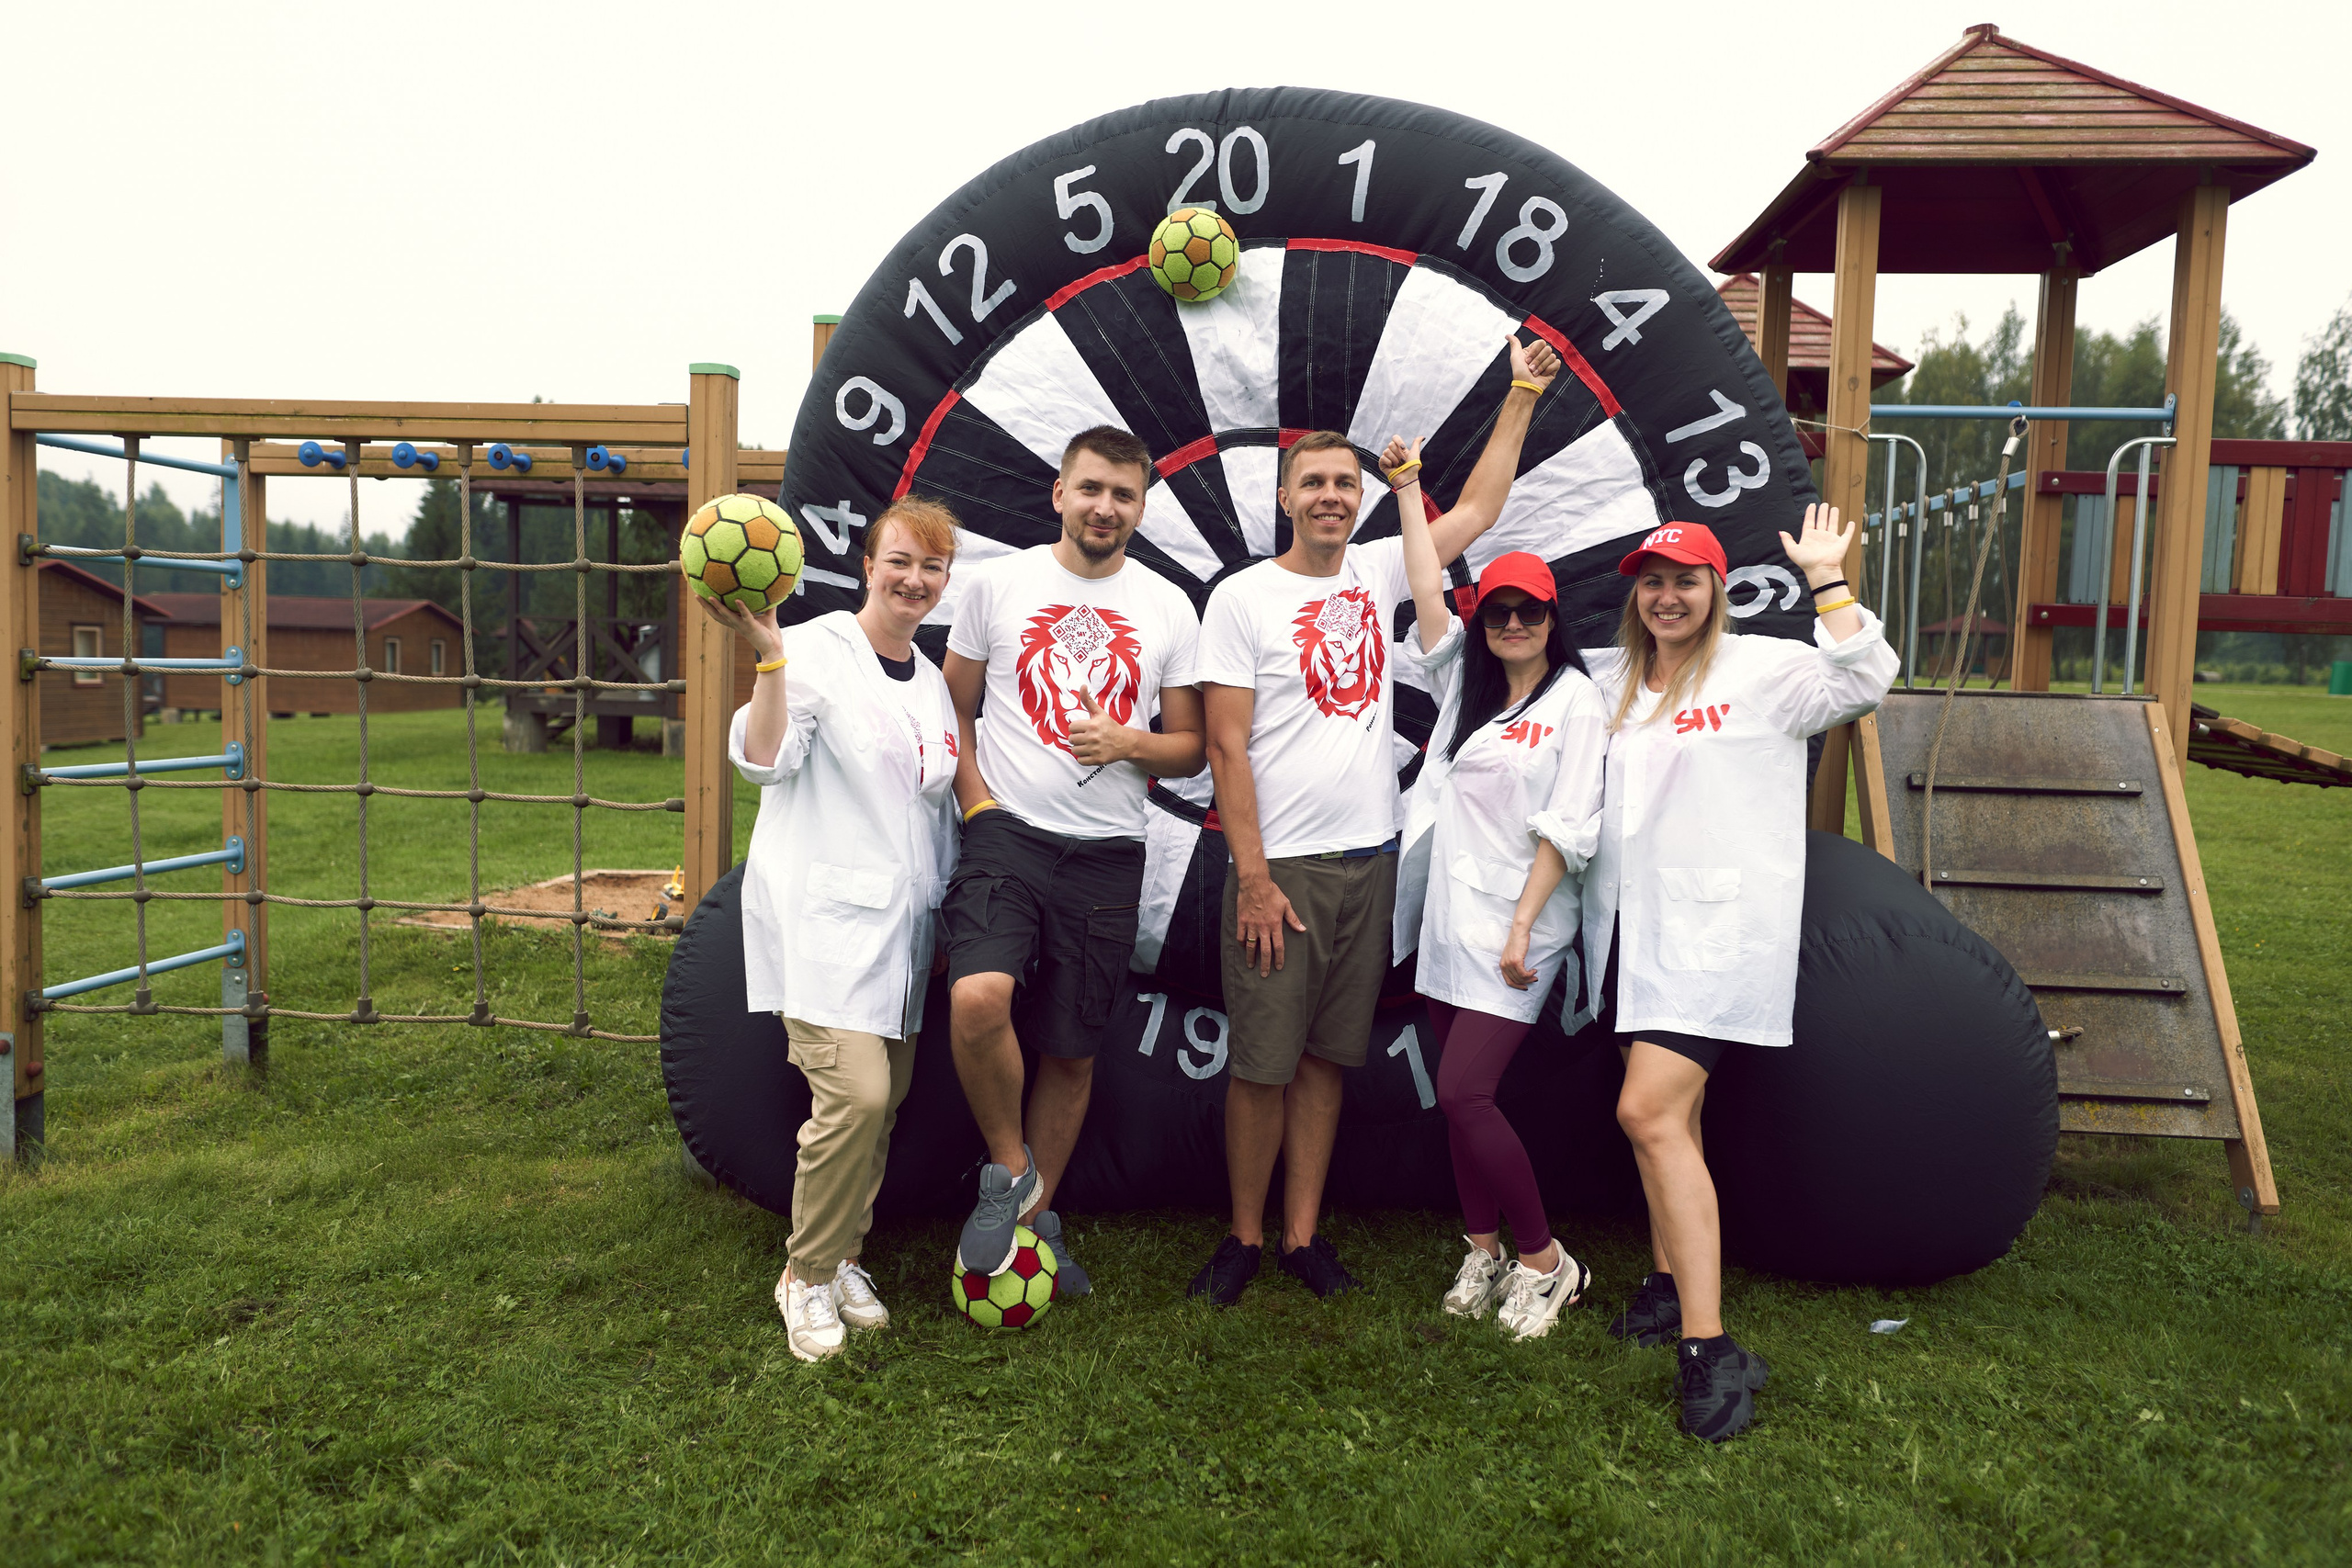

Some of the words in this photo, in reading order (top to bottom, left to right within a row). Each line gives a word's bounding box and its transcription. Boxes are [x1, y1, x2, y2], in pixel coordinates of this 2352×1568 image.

[1054, 164, 1115, 254] 5
[1165, 126, 1271, 215] 20
[1339, 139, 1376, 222] 1
[1456, 171, 1569, 283] 18
[903, 233, 1017, 346] 12
[1594, 288, 1671, 352] 4
[834, 375, 907, 446] 9
[1665, 389, 1771, 508] 13
[794, 500, 867, 596] 14
[1643, 528, 1683, 550] NYC
[1725, 563, 1802, 619] 6
[1076, 762, 1108, 788] Констан
[1136, 992, 1230, 1080] 19
[1386, 1023, 1437, 1110] 1
